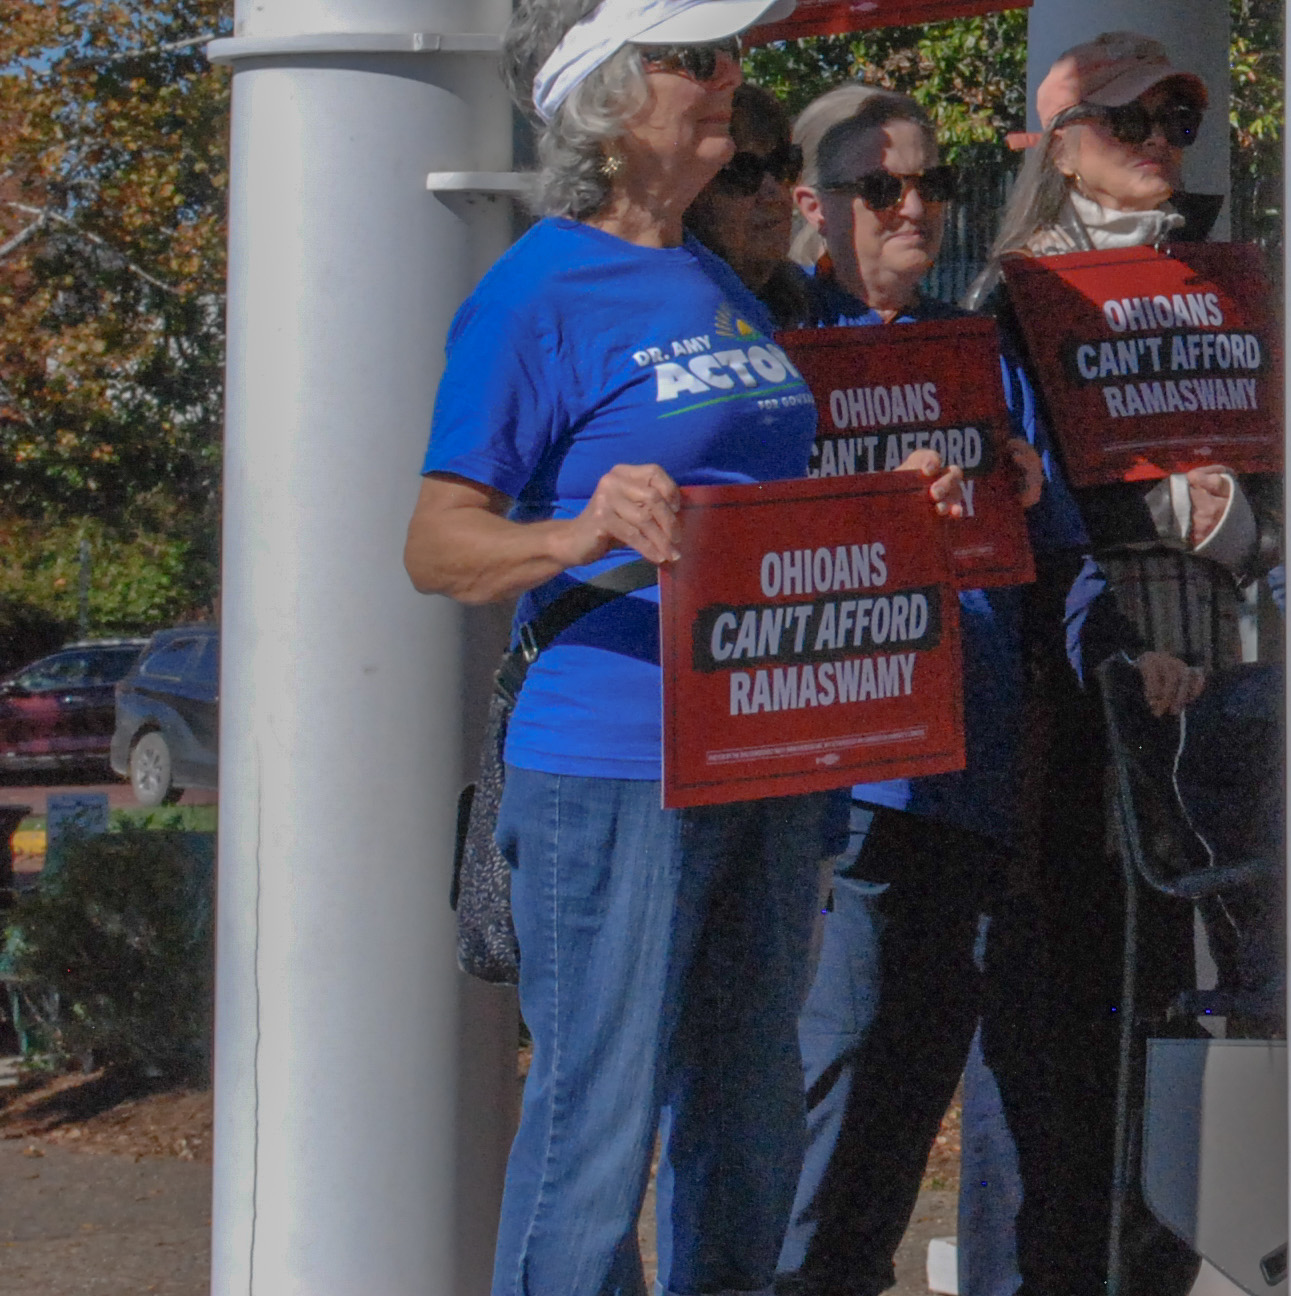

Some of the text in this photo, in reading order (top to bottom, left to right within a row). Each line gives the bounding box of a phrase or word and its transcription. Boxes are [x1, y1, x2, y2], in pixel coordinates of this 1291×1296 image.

[1103, 292, 1223, 332] OHIOANS
[632, 335, 712, 367] DR. AMY
[1076, 334, 1261, 380] CAN'T AFFORD
[830, 382, 941, 429] OHIOANS
[1103, 378, 1258, 418] RAMASWAMY
[761, 542, 887, 597] OHIOANS
[711, 594, 928, 661] CAN'T AFFORD
[730, 653, 915, 716] RAMASWAMY
